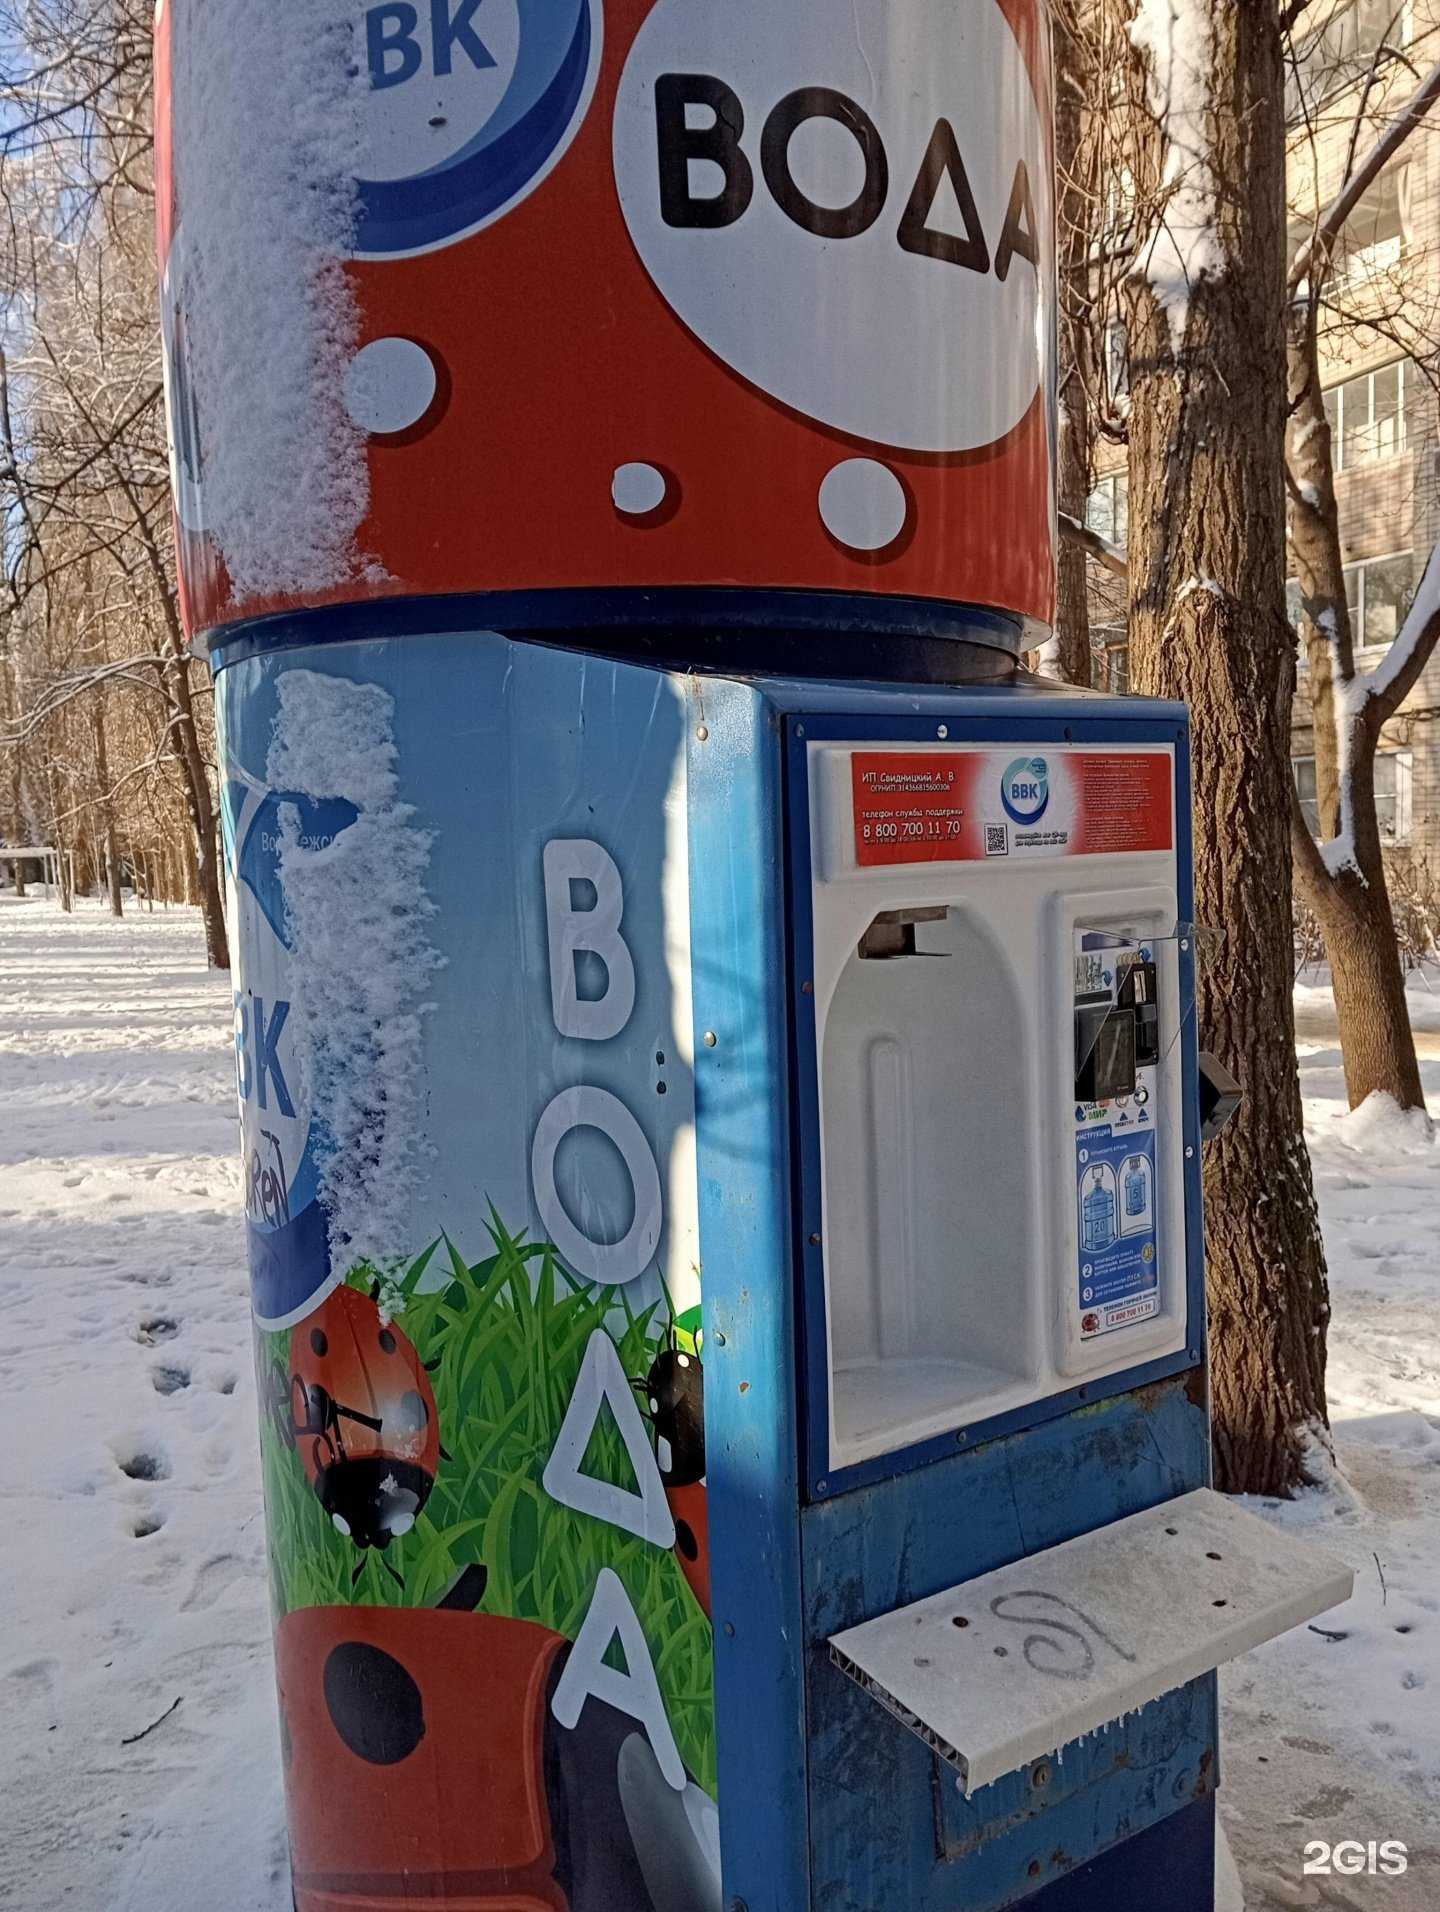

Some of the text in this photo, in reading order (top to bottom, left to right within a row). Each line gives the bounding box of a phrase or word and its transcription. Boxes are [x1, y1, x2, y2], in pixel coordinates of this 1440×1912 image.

[347, 0, 499, 91] ВК
[654, 72, 1040, 282] ВОДА
[862, 771, 877, 783] ИП
[862, 807, 964, 819] телефон службы поддержки
[863, 820, 961, 838] 8 800 700 11 70
